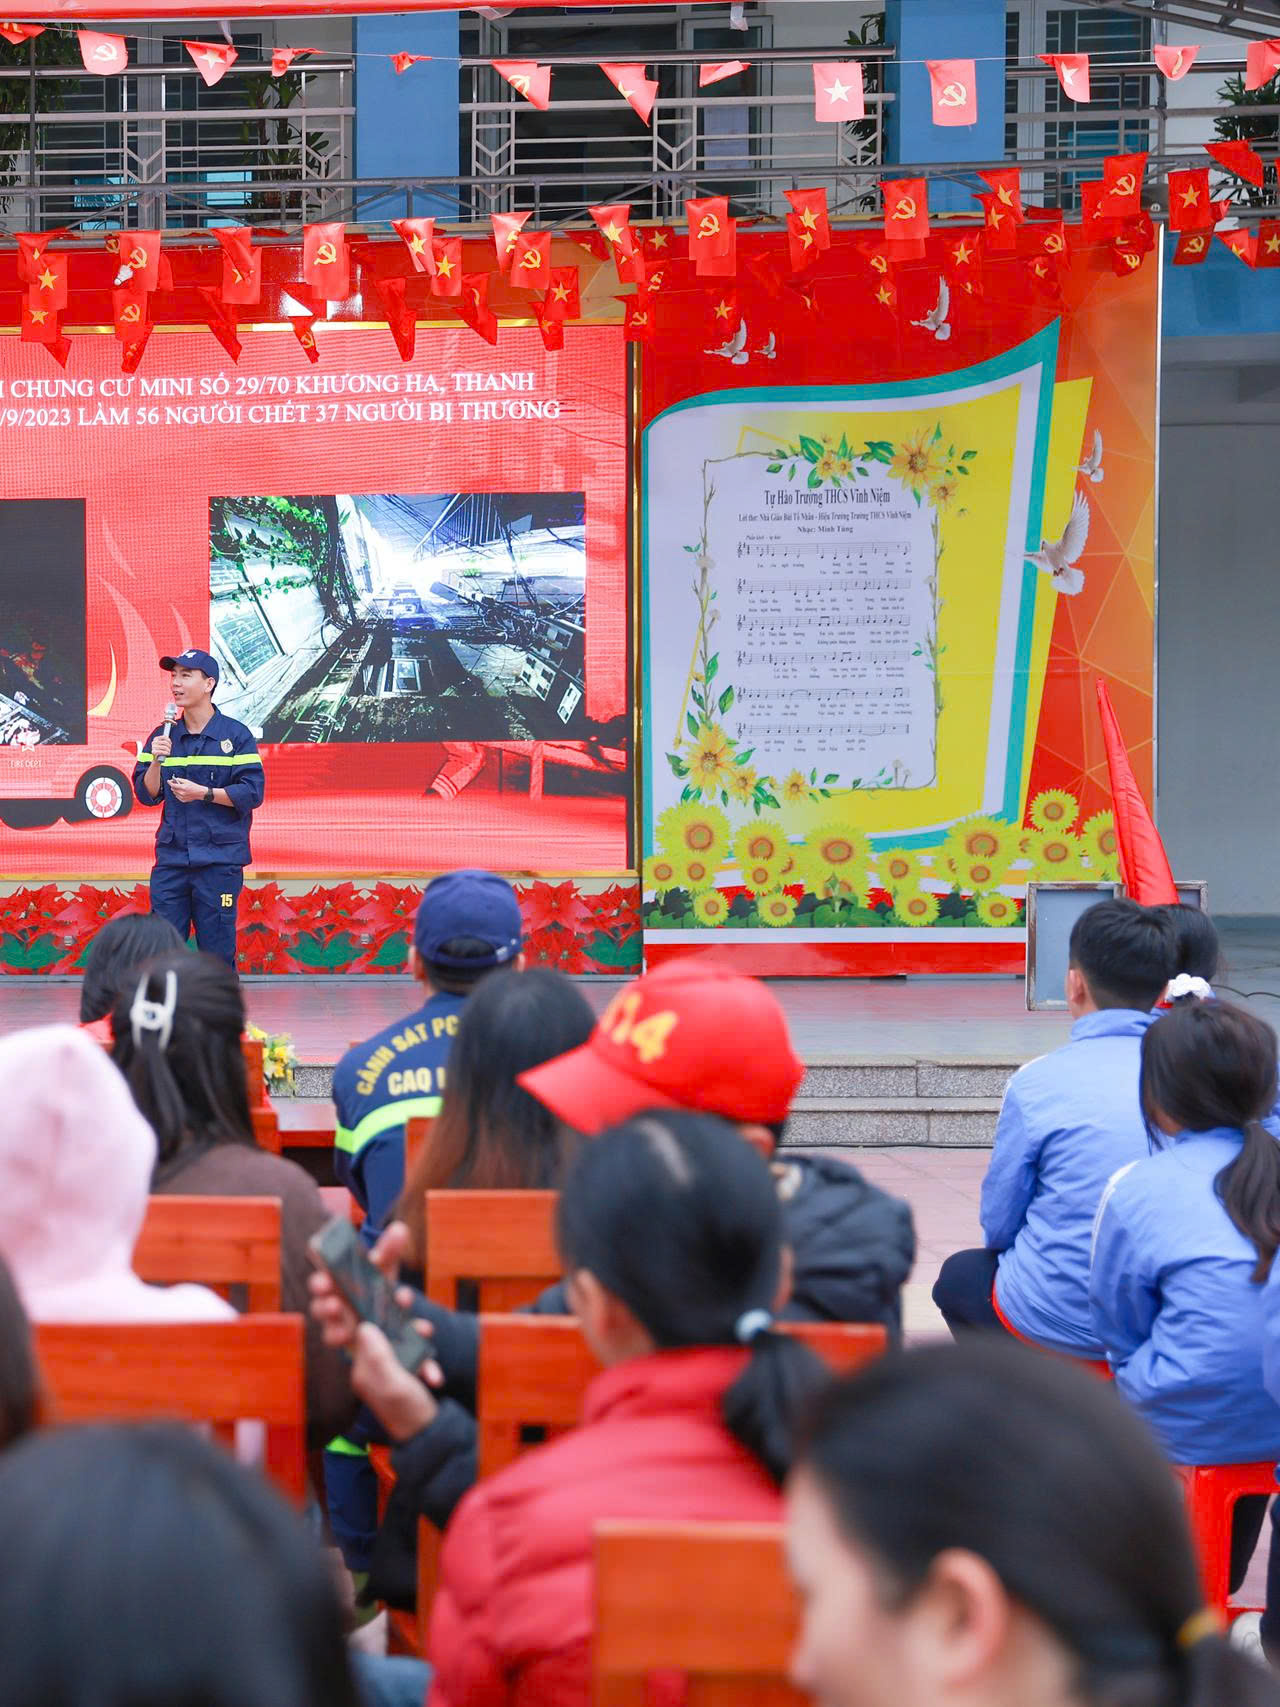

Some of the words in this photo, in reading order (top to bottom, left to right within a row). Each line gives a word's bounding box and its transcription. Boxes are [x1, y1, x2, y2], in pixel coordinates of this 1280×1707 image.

[11, 379, 94, 398] CHUNG
[100, 377, 135, 397] CƯ
[140, 377, 193, 397] MINI
[200, 372, 230, 396] SỐ
[235, 377, 290, 395] 29/70
[295, 374, 399, 394] KHƯƠNG
[405, 374, 445, 396] HẠ,
[451, 372, 535, 391] THANH
[78, 402, 129, 426] LÀM
[136, 406, 159, 425] 56
[165, 400, 242, 425] NGƯỜI
[248, 399, 310, 424] CHẾT
[316, 404, 339, 423] 37
[345, 398, 422, 421] NGƯỜI
[429, 402, 452, 423] BỊ
[459, 400, 560, 420] THƯƠNG
[824, 488, 848, 504] THCS
[220, 893, 233, 908] 15
[431, 1014, 460, 1038] PC
